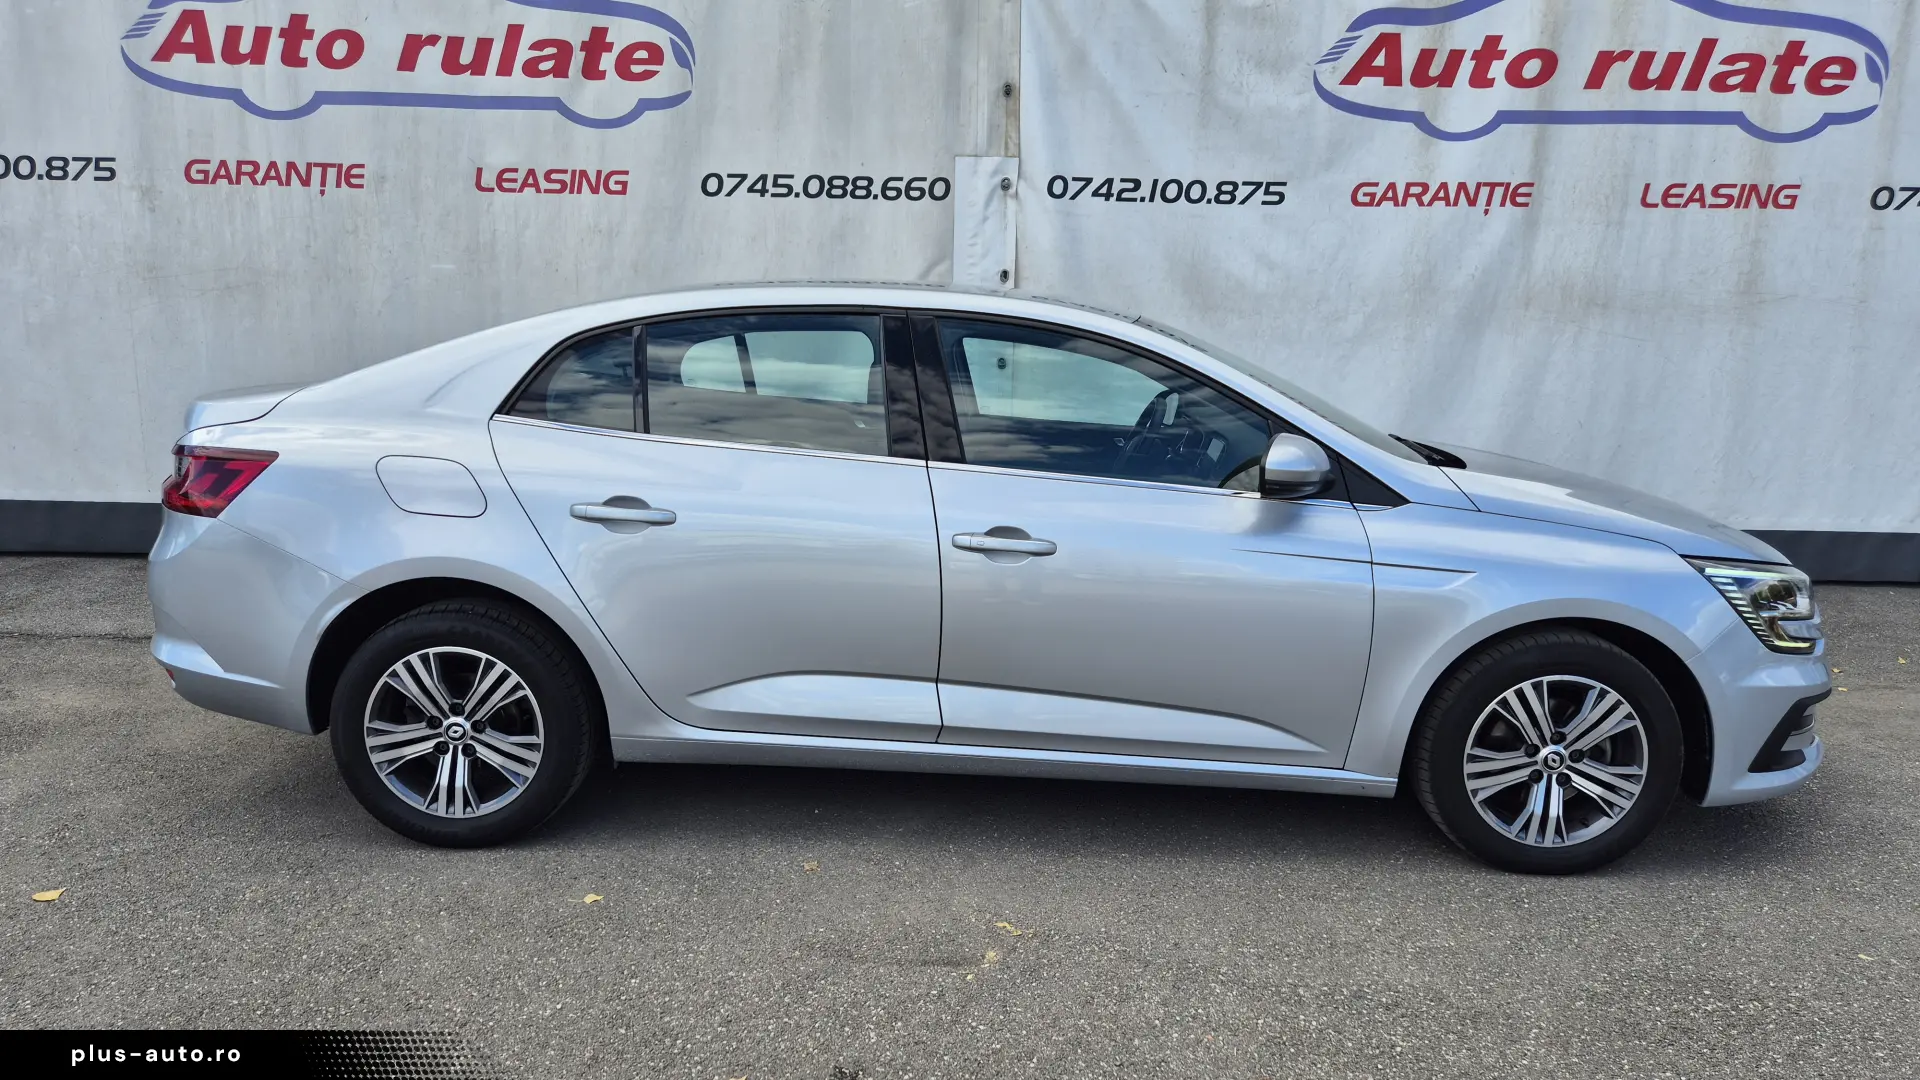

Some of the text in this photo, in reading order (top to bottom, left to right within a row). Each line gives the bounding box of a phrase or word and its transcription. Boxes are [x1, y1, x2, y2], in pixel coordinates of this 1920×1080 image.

[152, 9, 665, 82] Auto rulate
[1339, 32, 1857, 96] Auto rulate
[184, 158, 366, 197] GARANȚIE
[475, 166, 630, 196] LEASING
[700, 172, 952, 202] 0745.088.660
[1046, 174, 1288, 206] 0742.100.875
[1350, 181, 1535, 217] GARANȚIE
[1640, 183, 1801, 210] LEASING
[1870, 185, 1920, 211] 07
